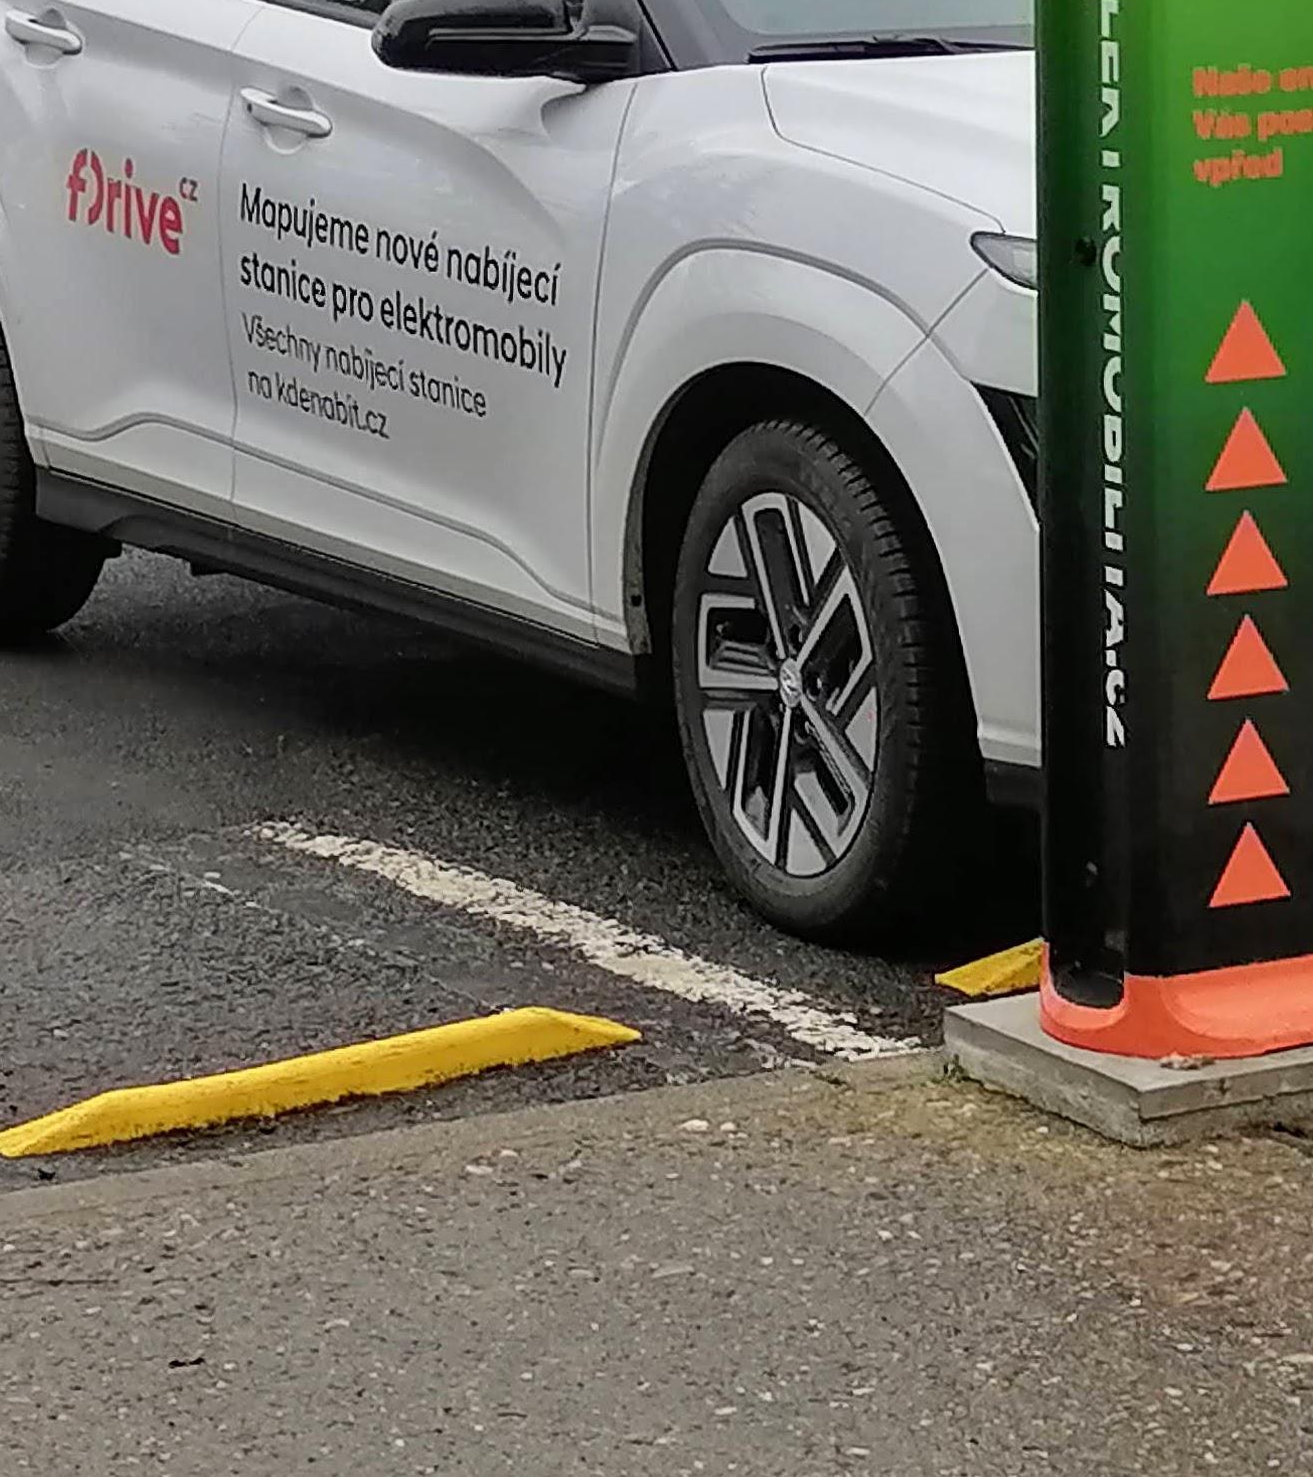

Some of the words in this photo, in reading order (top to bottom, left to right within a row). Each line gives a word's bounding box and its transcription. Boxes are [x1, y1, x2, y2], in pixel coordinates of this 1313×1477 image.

[1193, 63, 1272, 97] Naše
[1193, 107, 1251, 140] Vás
[66, 148, 183, 255] fDrive
[1193, 147, 1284, 187] vpřed
[240, 182, 369, 255] Mapujeme
[376, 231, 440, 274] nové
[446, 248, 562, 306] nabíjecí
[240, 251, 327, 308] stanice
[331, 282, 374, 324] pro
[380, 291, 568, 389] elektromobily
[241, 310, 322, 374] Všechny
[326, 337, 405, 392] nabíjecí
[409, 369, 488, 418] stanice
[248, 367, 272, 401] na
